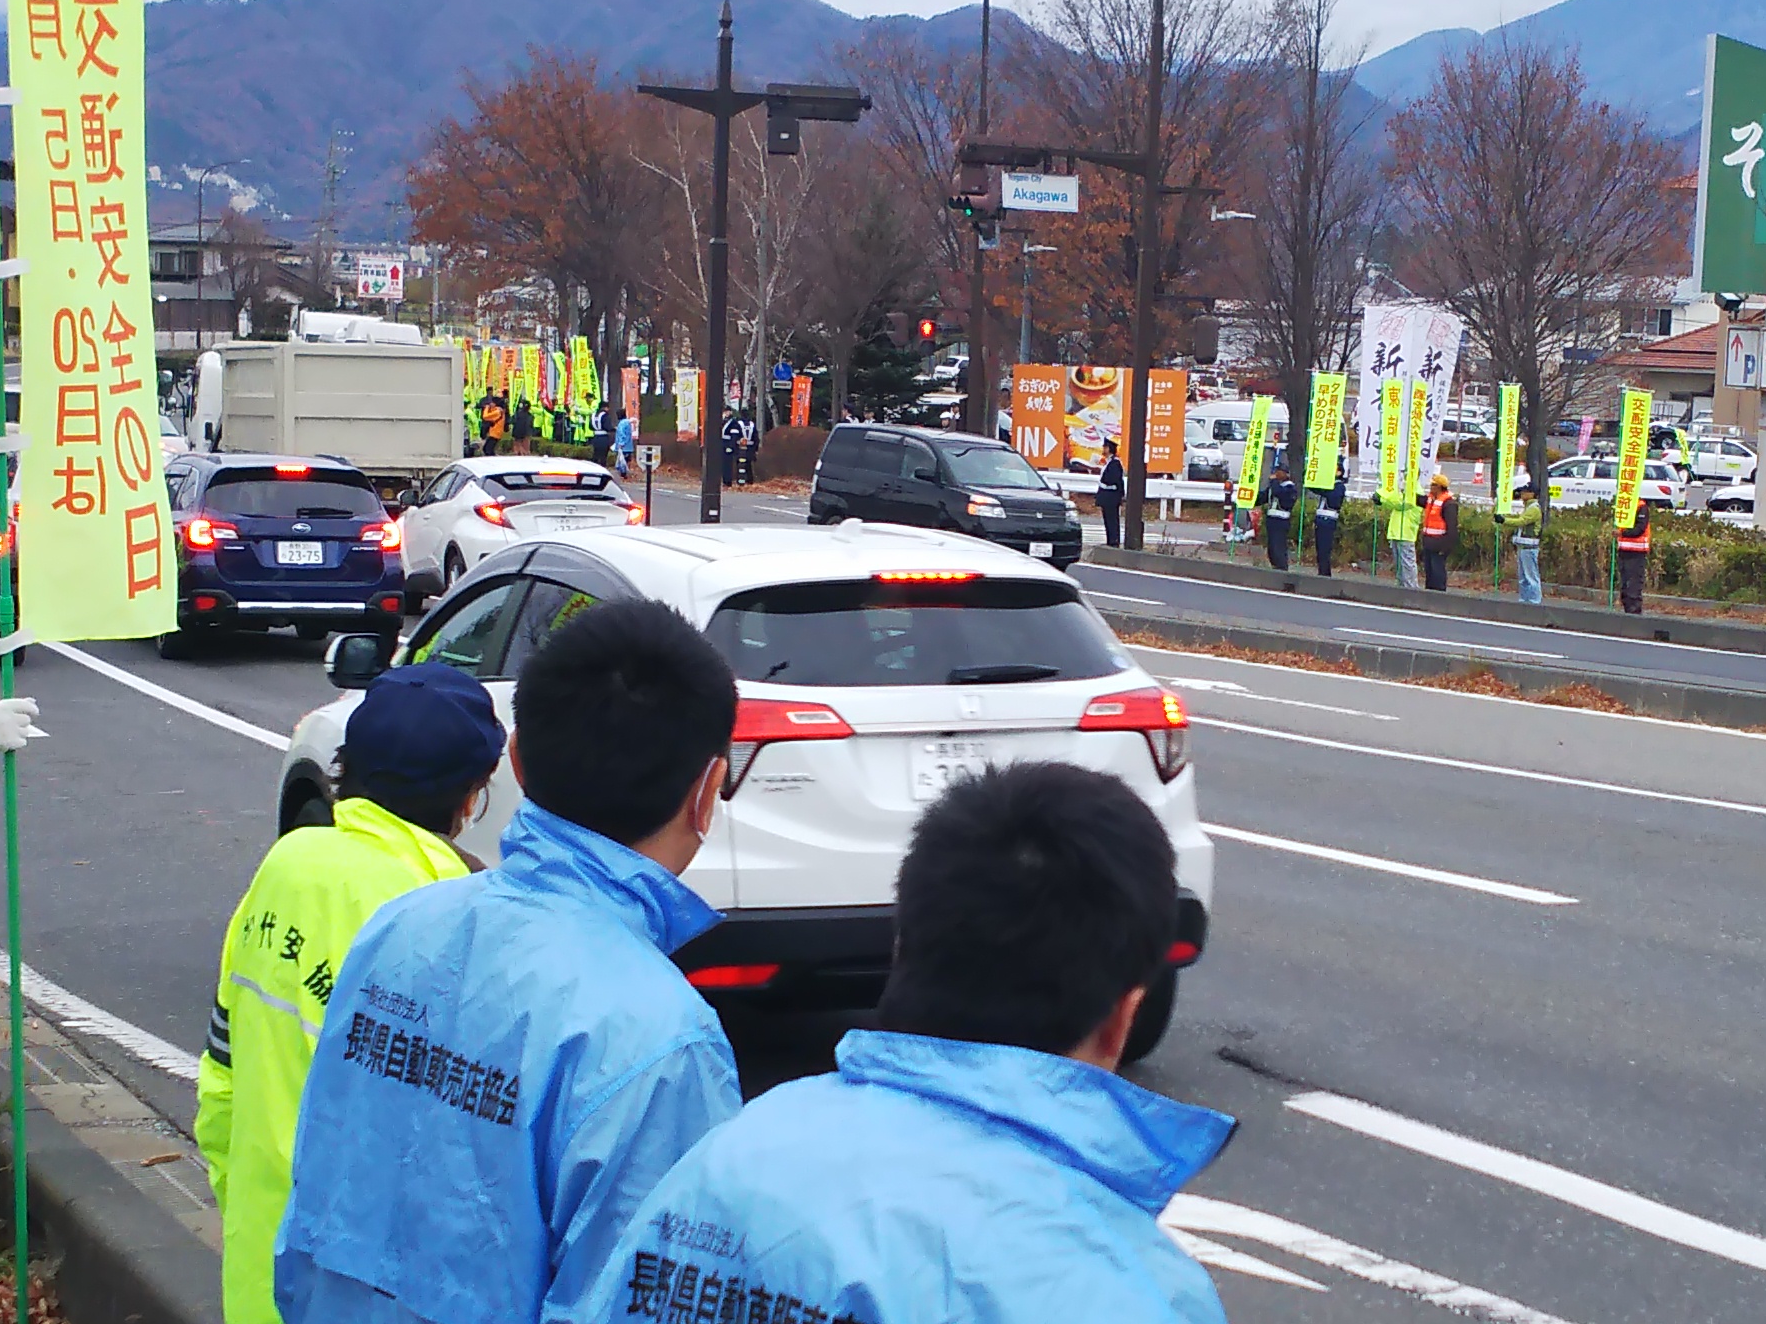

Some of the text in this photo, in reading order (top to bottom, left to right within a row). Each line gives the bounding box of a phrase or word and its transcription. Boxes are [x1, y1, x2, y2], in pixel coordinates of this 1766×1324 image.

[1012, 187, 1069, 204] Akagawa
[1743, 354, 1756, 383] P
[680, 378, 695, 422] カレー
[1324, 382, 1341, 443] 夕暮れ時は
[1016, 426, 1041, 457] IN
[1306, 383, 1330, 482] 早めのライト点灯
